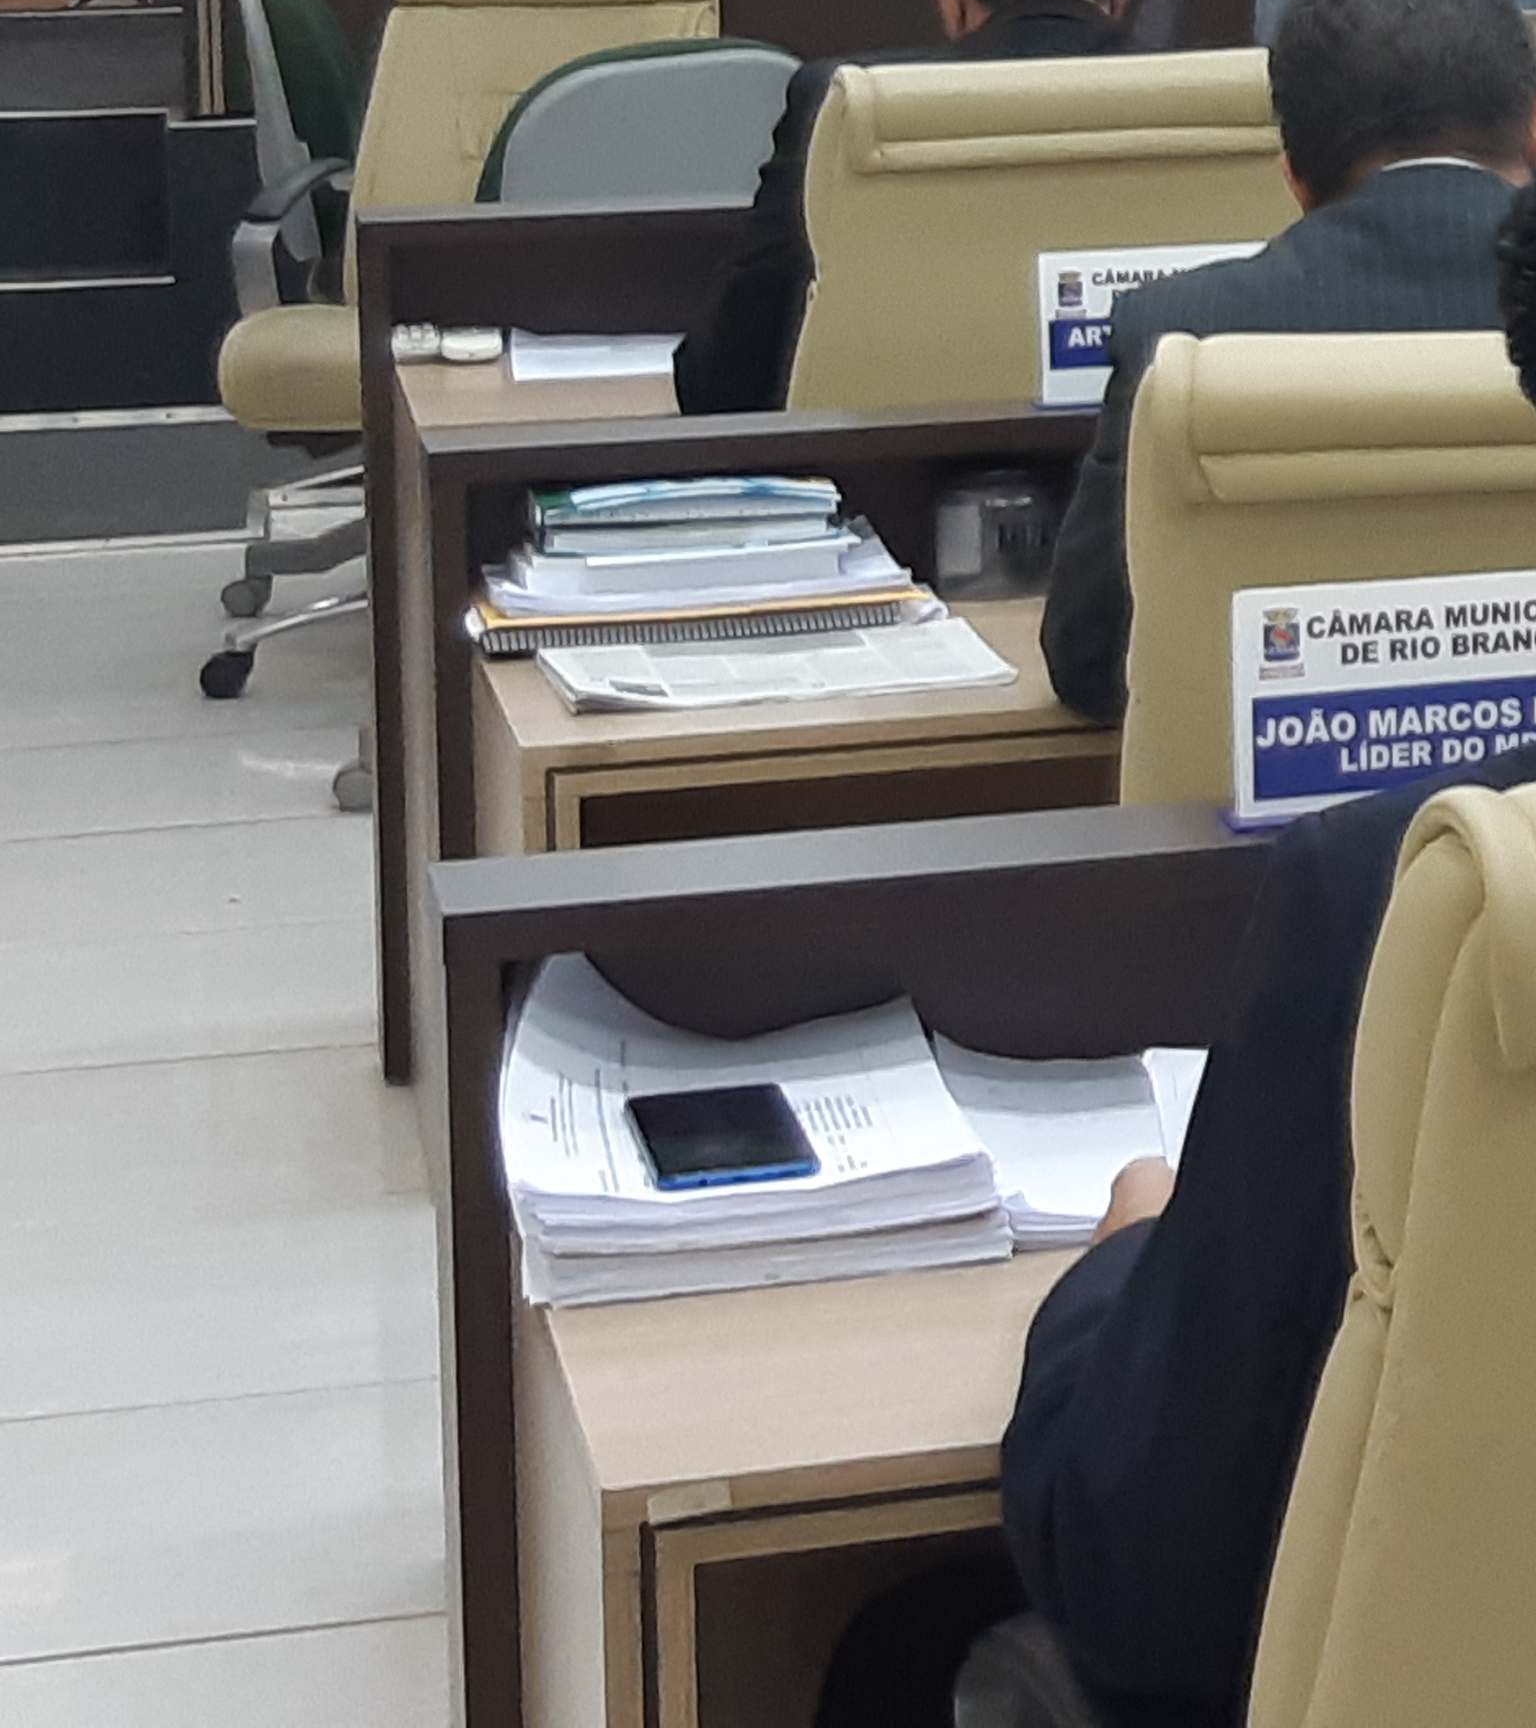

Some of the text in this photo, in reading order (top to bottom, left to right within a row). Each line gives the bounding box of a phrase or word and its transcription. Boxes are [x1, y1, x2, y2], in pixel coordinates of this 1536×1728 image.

[1306, 606, 1435, 640] CÂMARA
[1340, 640, 1379, 666] DE
[1389, 635, 1441, 662] RIO
[1255, 707, 1356, 748] JOÃO
[1369, 696, 1523, 740] MARCOS
[1340, 736, 1432, 773] LÍDER
[1442, 736, 1485, 765] DO
